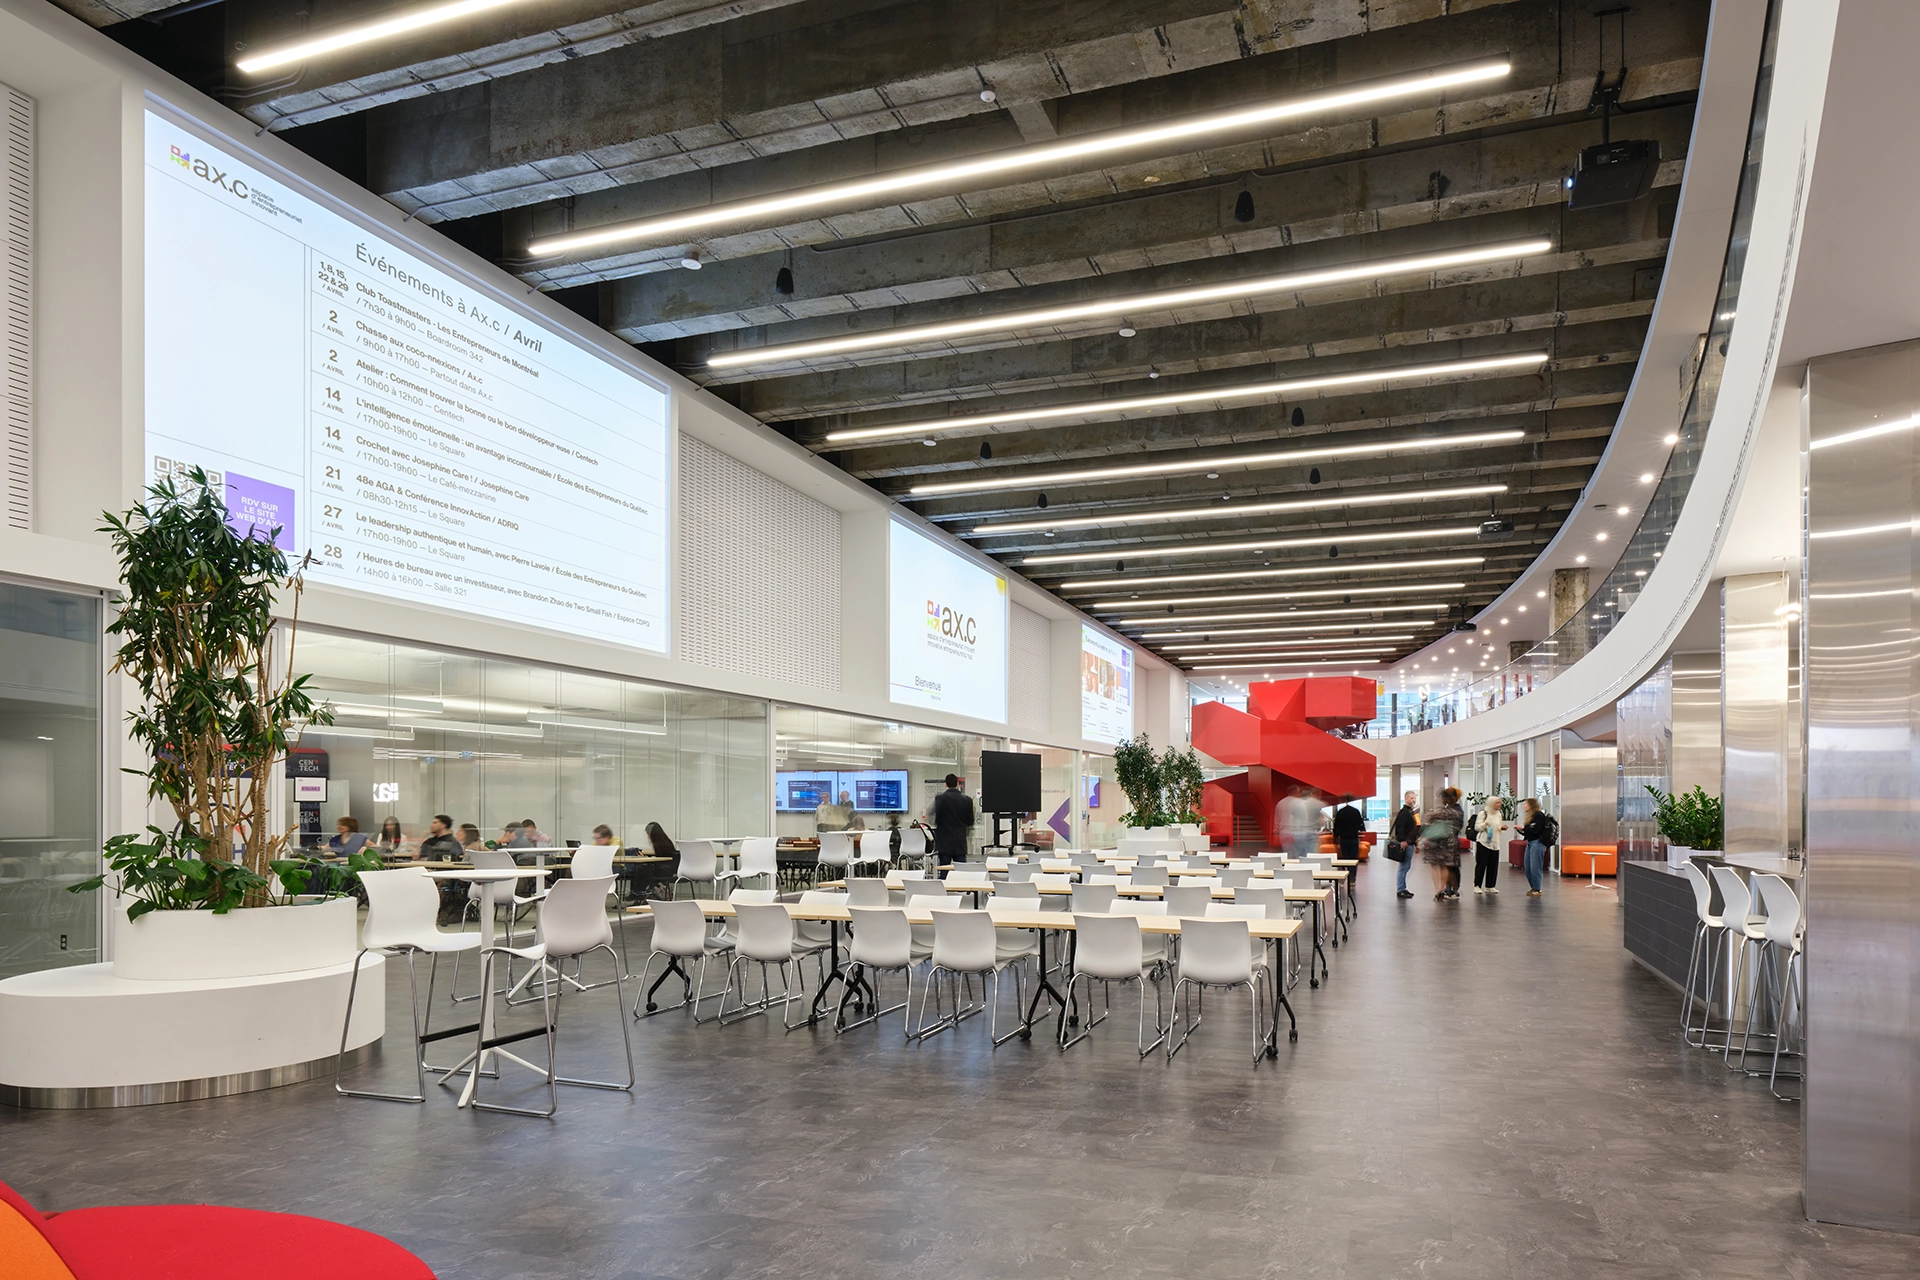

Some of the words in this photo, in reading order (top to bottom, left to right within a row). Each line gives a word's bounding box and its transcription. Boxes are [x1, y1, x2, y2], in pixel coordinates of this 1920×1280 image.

[193, 157, 248, 199] ax.c
[251, 188, 274, 203] espace
[251, 200, 278, 217] innovant
[251, 194, 303, 224] d'entrepreneuriat
[317, 270, 330, 283] 22
[329, 276, 337, 287] &
[337, 279, 349, 292] 29
[326, 284, 345, 299] AVRIL
[355, 241, 454, 308] Événements
[456, 296, 467, 315] à
[469, 305, 501, 332] Ax.c
[512, 328, 543, 353] Avril
[327, 308, 340, 327] 2
[326, 324, 345, 338] AVRIL
[355, 281, 376, 298] Club
[377, 291, 432, 326] Toastmasters
[436, 321, 451, 335] Les
[451, 328, 501, 360] Entrepreneurs
[501, 354, 511, 364] de
[511, 358, 539, 378] Montréal
[361, 297, 386, 317] 7h30
[386, 309, 394, 321] à
[394, 313, 417, 332] 9h00
[426, 328, 468, 356] Boardroom
[468, 350, 484, 364] 342
[327, 346, 339, 366] 2
[355, 319, 388, 341] Chasse
[388, 336, 404, 349] aux
[405, 344, 461, 374] coco-nnexions
[466, 370, 483, 385] Ax.c
[326, 363, 345, 377] AVRIL
[361, 336, 386, 354] 9h00
[386, 346, 394, 358] à
[394, 351, 421, 369] 17h00
[429, 366, 458, 386] Partout
[458, 380, 477, 395] dans
[477, 388, 494, 402] Ax.c
[324, 385, 342, 403] 14
[355, 358, 384, 377] Atelier
[389, 372, 428, 396] Comment
[428, 389, 456, 407] trouver
[456, 400, 464, 410] la
[464, 403, 487, 420] bonne
[486, 414, 497, 424] ou
[496, 417, 504, 427] le
[504, 420, 517, 432] bon
[362, 374, 390, 393] 10h00
[390, 385, 397, 396] à
[397, 389, 424, 407] 12h00
[433, 403, 465, 424] Centech
[326, 402, 345, 414] AVRIL
[323, 425, 342, 442] 14
[356, 396, 411, 425] L'intelligence
[411, 418, 461, 444] émotionnelle
[464, 439, 475, 449] un
[475, 443, 506, 461] avantage
[506, 454, 552, 479] incontournable
[556, 472, 574, 487] École
[362, 413, 418, 441] 17h00-19h00
[427, 437, 438, 448] Le
[438, 441, 466, 458] Square
[326, 441, 344, 454] AVRIL
[324, 464, 341, 481] 21
[355, 434, 390, 454] Crochet
[391, 448, 410, 461] avec
[411, 454, 451, 475] Josephine
[451, 468, 470, 481] Care
[478, 478, 514, 497] Josephine
[514, 489, 530, 502] Care
[362, 451, 418, 477] 17h00-19h00
[427, 472, 438, 484] Le
[438, 476, 497, 503] Café-mezzanine
[326, 481, 344, 492] AVRIL
[241, 496, 259, 508] RDV
[261, 500, 278, 512] SUR
[244, 505, 256, 514] LE
[257, 508, 276, 520] SITE
[323, 503, 343, 520] 27
[355, 474, 374, 487] 48e
[375, 479, 395, 493] AGA
[396, 486, 404, 496] &
[404, 488, 449, 510] Conférence
[449, 502, 491, 522] InnovAction
[496, 517, 519, 531] ADRIQ
[362, 489, 418, 514] 08h30-12h15
[427, 508, 438, 520] Le
[438, 511, 466, 528] Square
[236, 511, 256, 523] WEB
[258, 516, 286, 530] D'AXC
[325, 520, 345, 532] AVRIL
[323, 543, 343, 559] 28
[355, 511, 368, 523] Le
[368, 514, 412, 536] leadership
[412, 528, 457, 547] authentique
[457, 541, 466, 549] et
[466, 542, 494, 558] humain,
[494, 551, 510, 561] avec
[510, 554, 530, 567] Pierre
[530, 559, 551, 572] Lavoie
[555, 565, 572, 578] École
[362, 527, 418, 550] 17h00-19h00
[427, 544, 438, 555] Le
[438, 546, 466, 562] Square
[326, 560, 344, 570] AVRIL
[362, 551, 393, 567] Heures
[394, 560, 405, 570] de
[406, 562, 434, 576] bureau
[434, 570, 452, 581] avec
[453, 574, 463, 583] un
[463, 575, 506, 594] investisseur,
[506, 587, 522, 597] avec
[522, 589, 549, 603] Brandon
[549, 596, 565, 607] Zhao
[362, 566, 390, 580] 14h00
[390, 571, 397, 582] à
[397, 574, 424, 588] 16h00
[433, 581, 453, 594] Salle
[452, 585, 467, 597] 321
[942, 606, 976, 645] ax.c
[915, 675, 942, 692] Bienvenue
